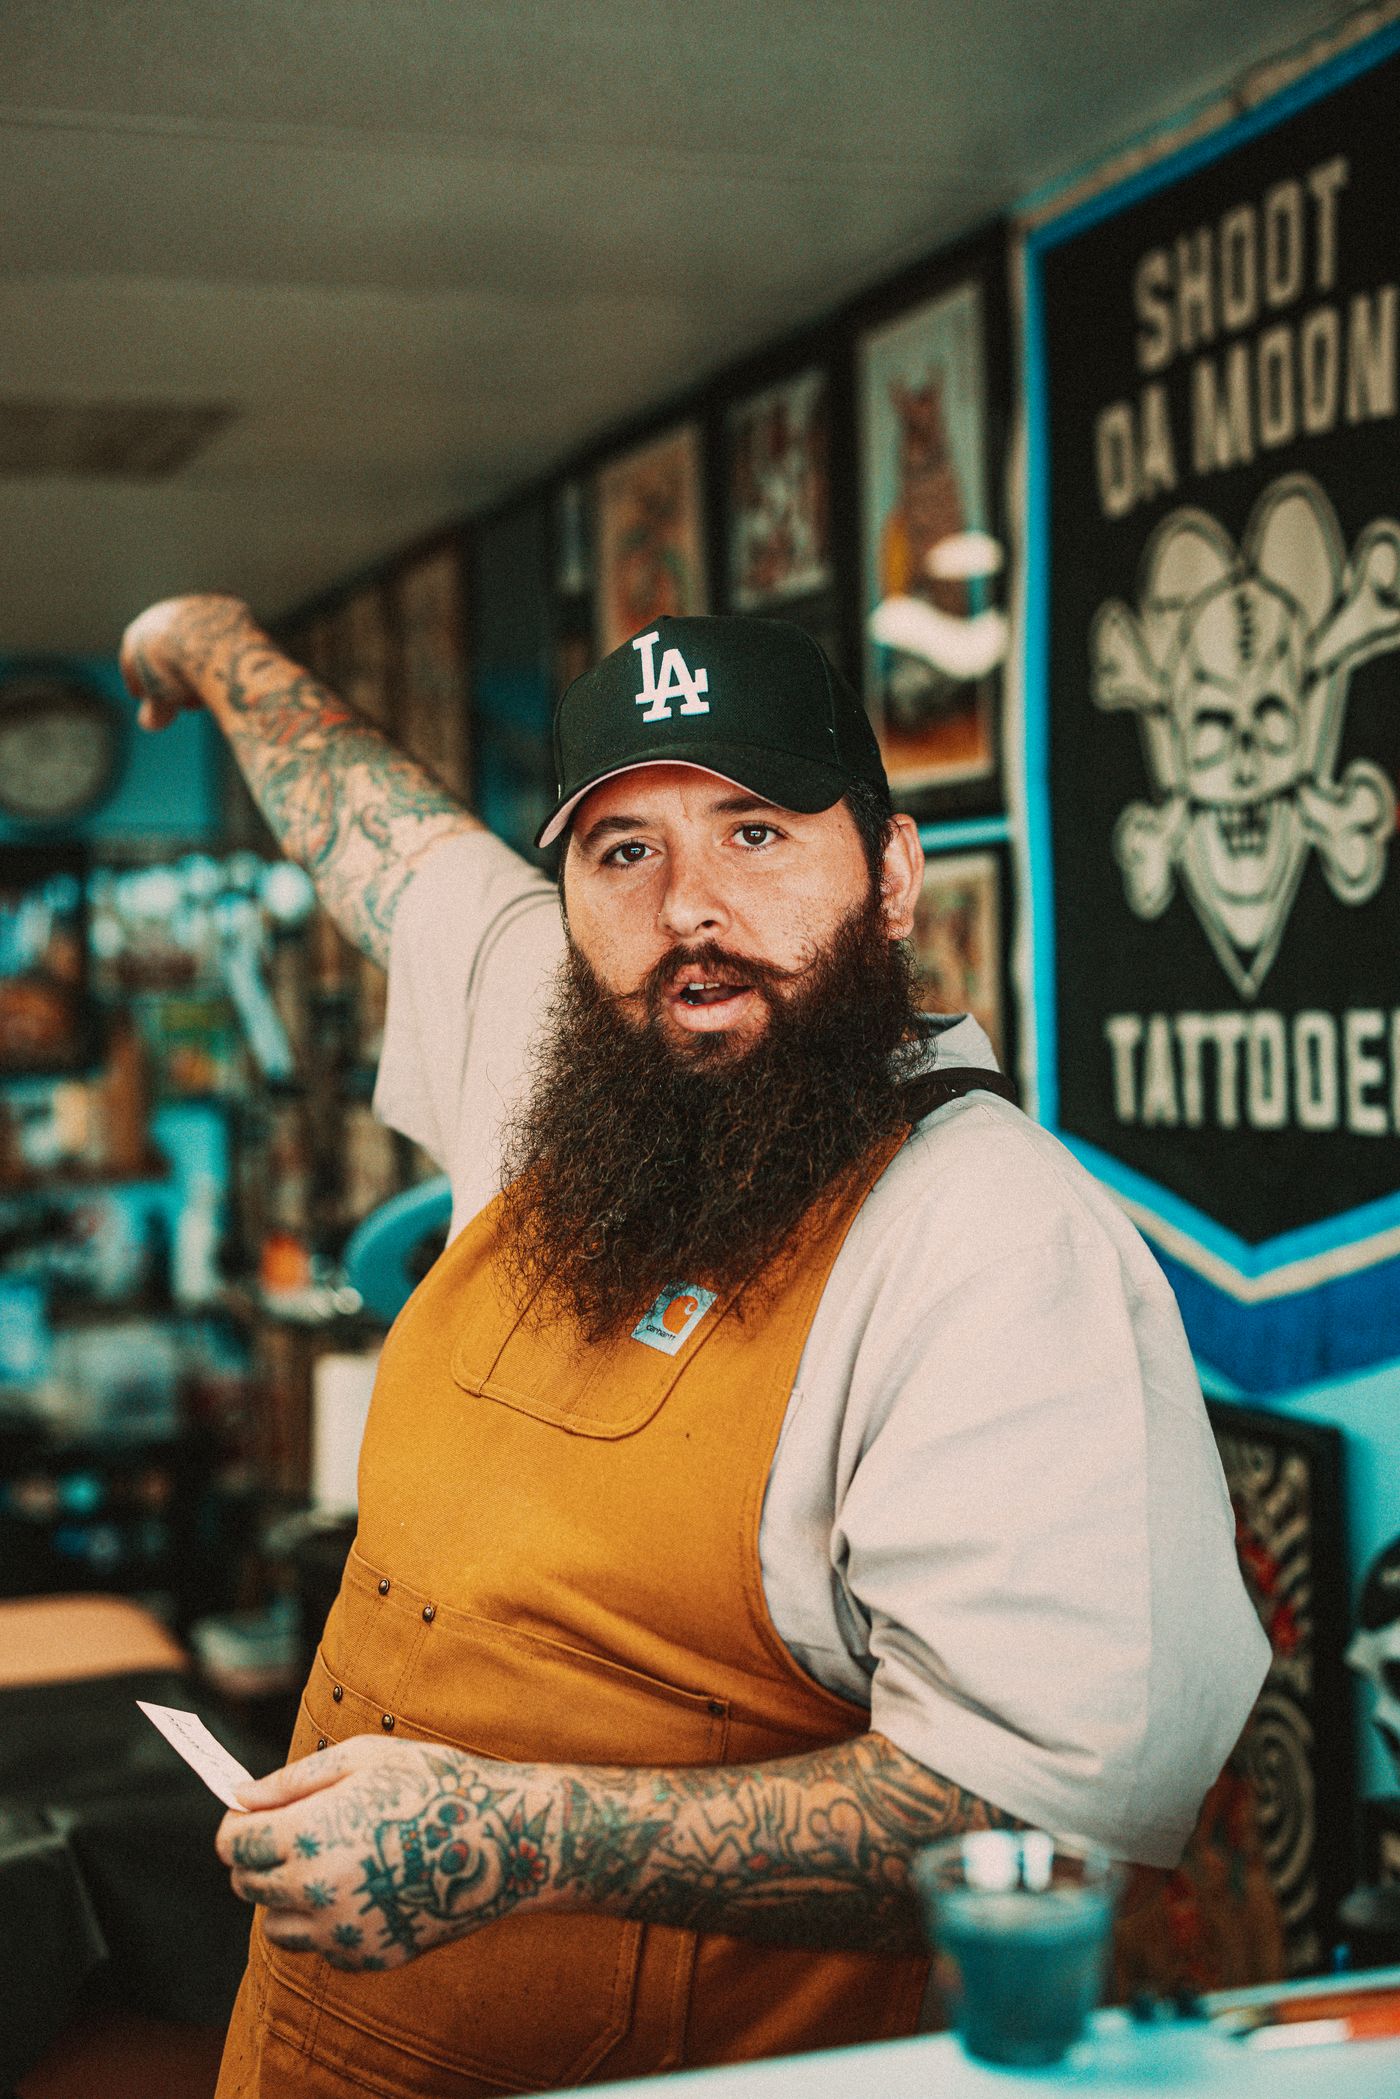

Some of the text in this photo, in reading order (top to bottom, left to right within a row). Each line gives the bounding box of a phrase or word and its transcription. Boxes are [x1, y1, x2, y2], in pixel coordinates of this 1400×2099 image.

[1135, 156, 1348, 370] SHOOT
[1193, 286, 1397, 473] MOON
[632, 631, 710, 722] LA
[1106, 1010, 1400, 1136] TATTOOE
